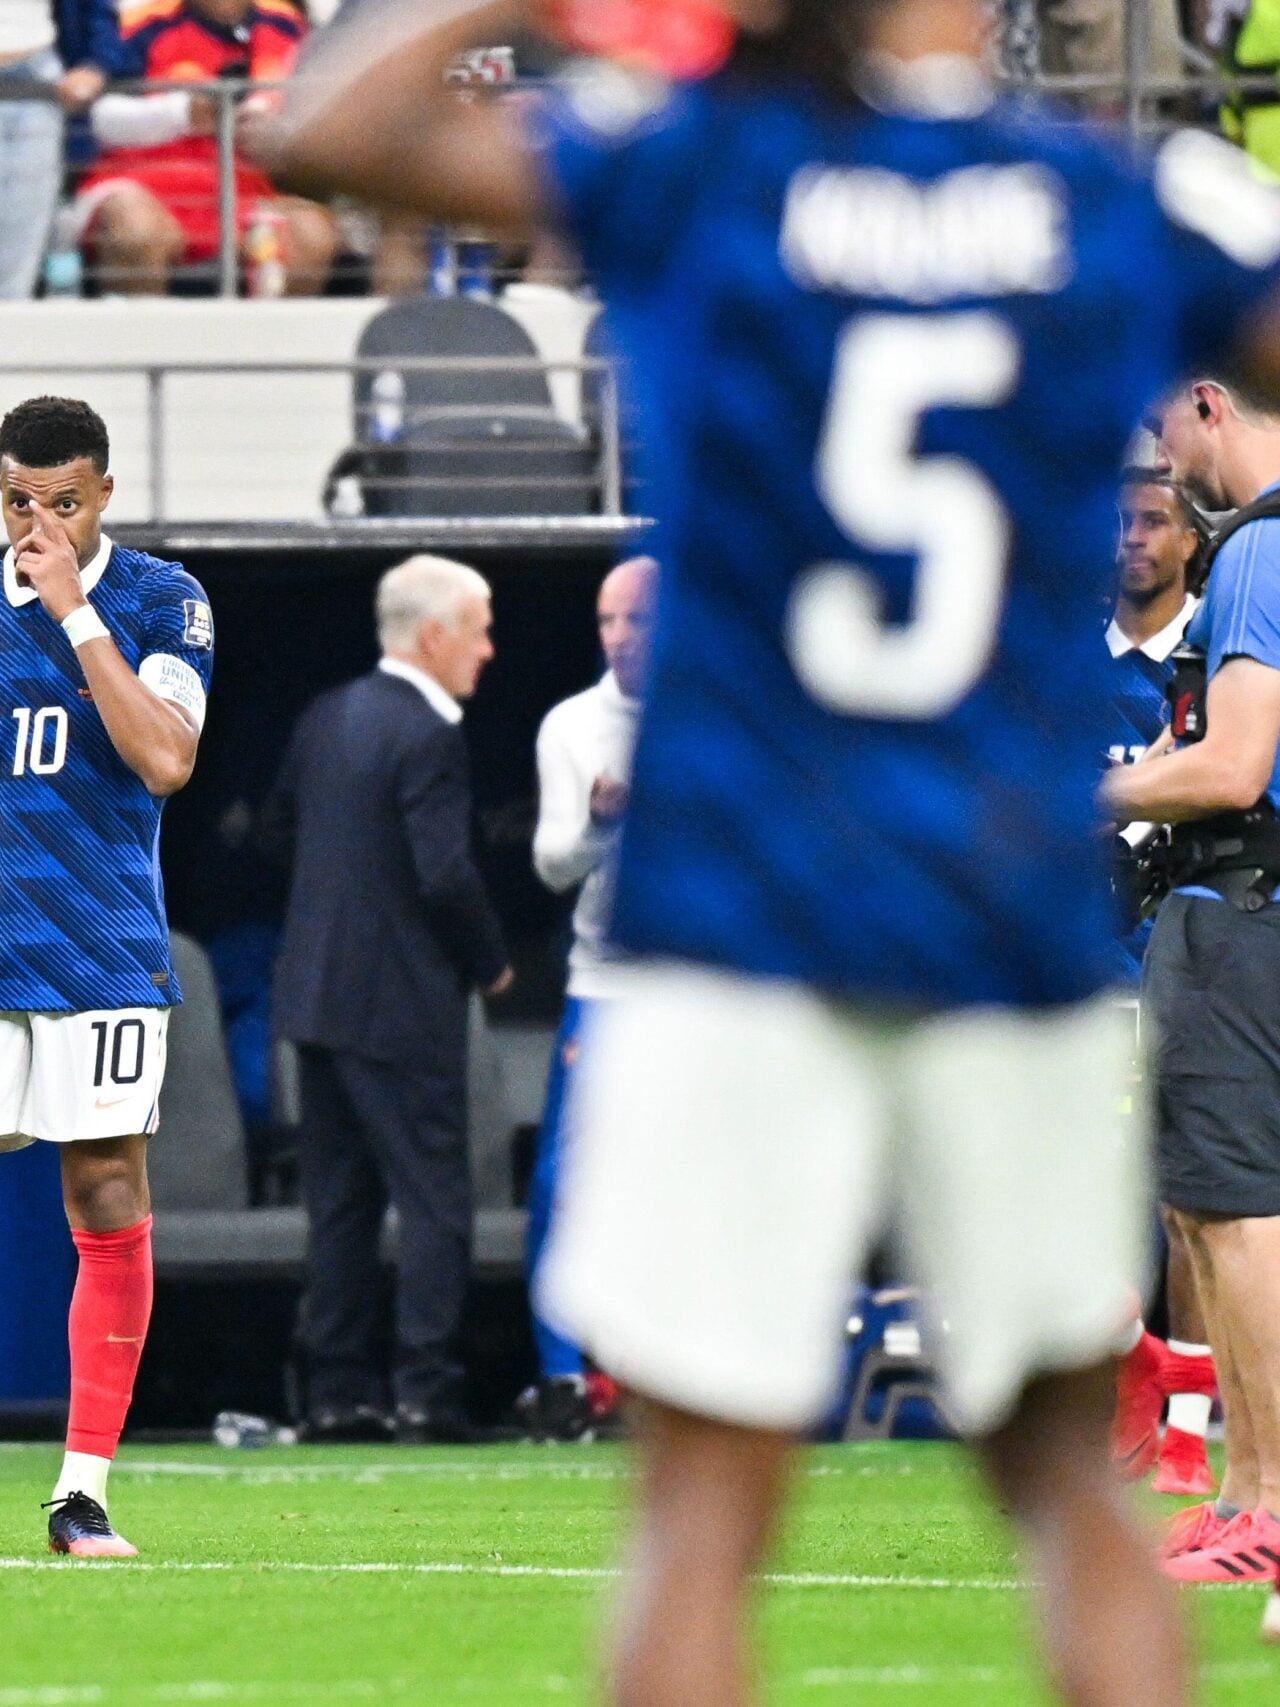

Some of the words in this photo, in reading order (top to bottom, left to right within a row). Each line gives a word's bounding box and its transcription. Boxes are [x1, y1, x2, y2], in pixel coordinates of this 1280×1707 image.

[784, 308, 1022, 722] 5
[12, 706, 68, 776] 10
[90, 1018, 145, 1087] 10
